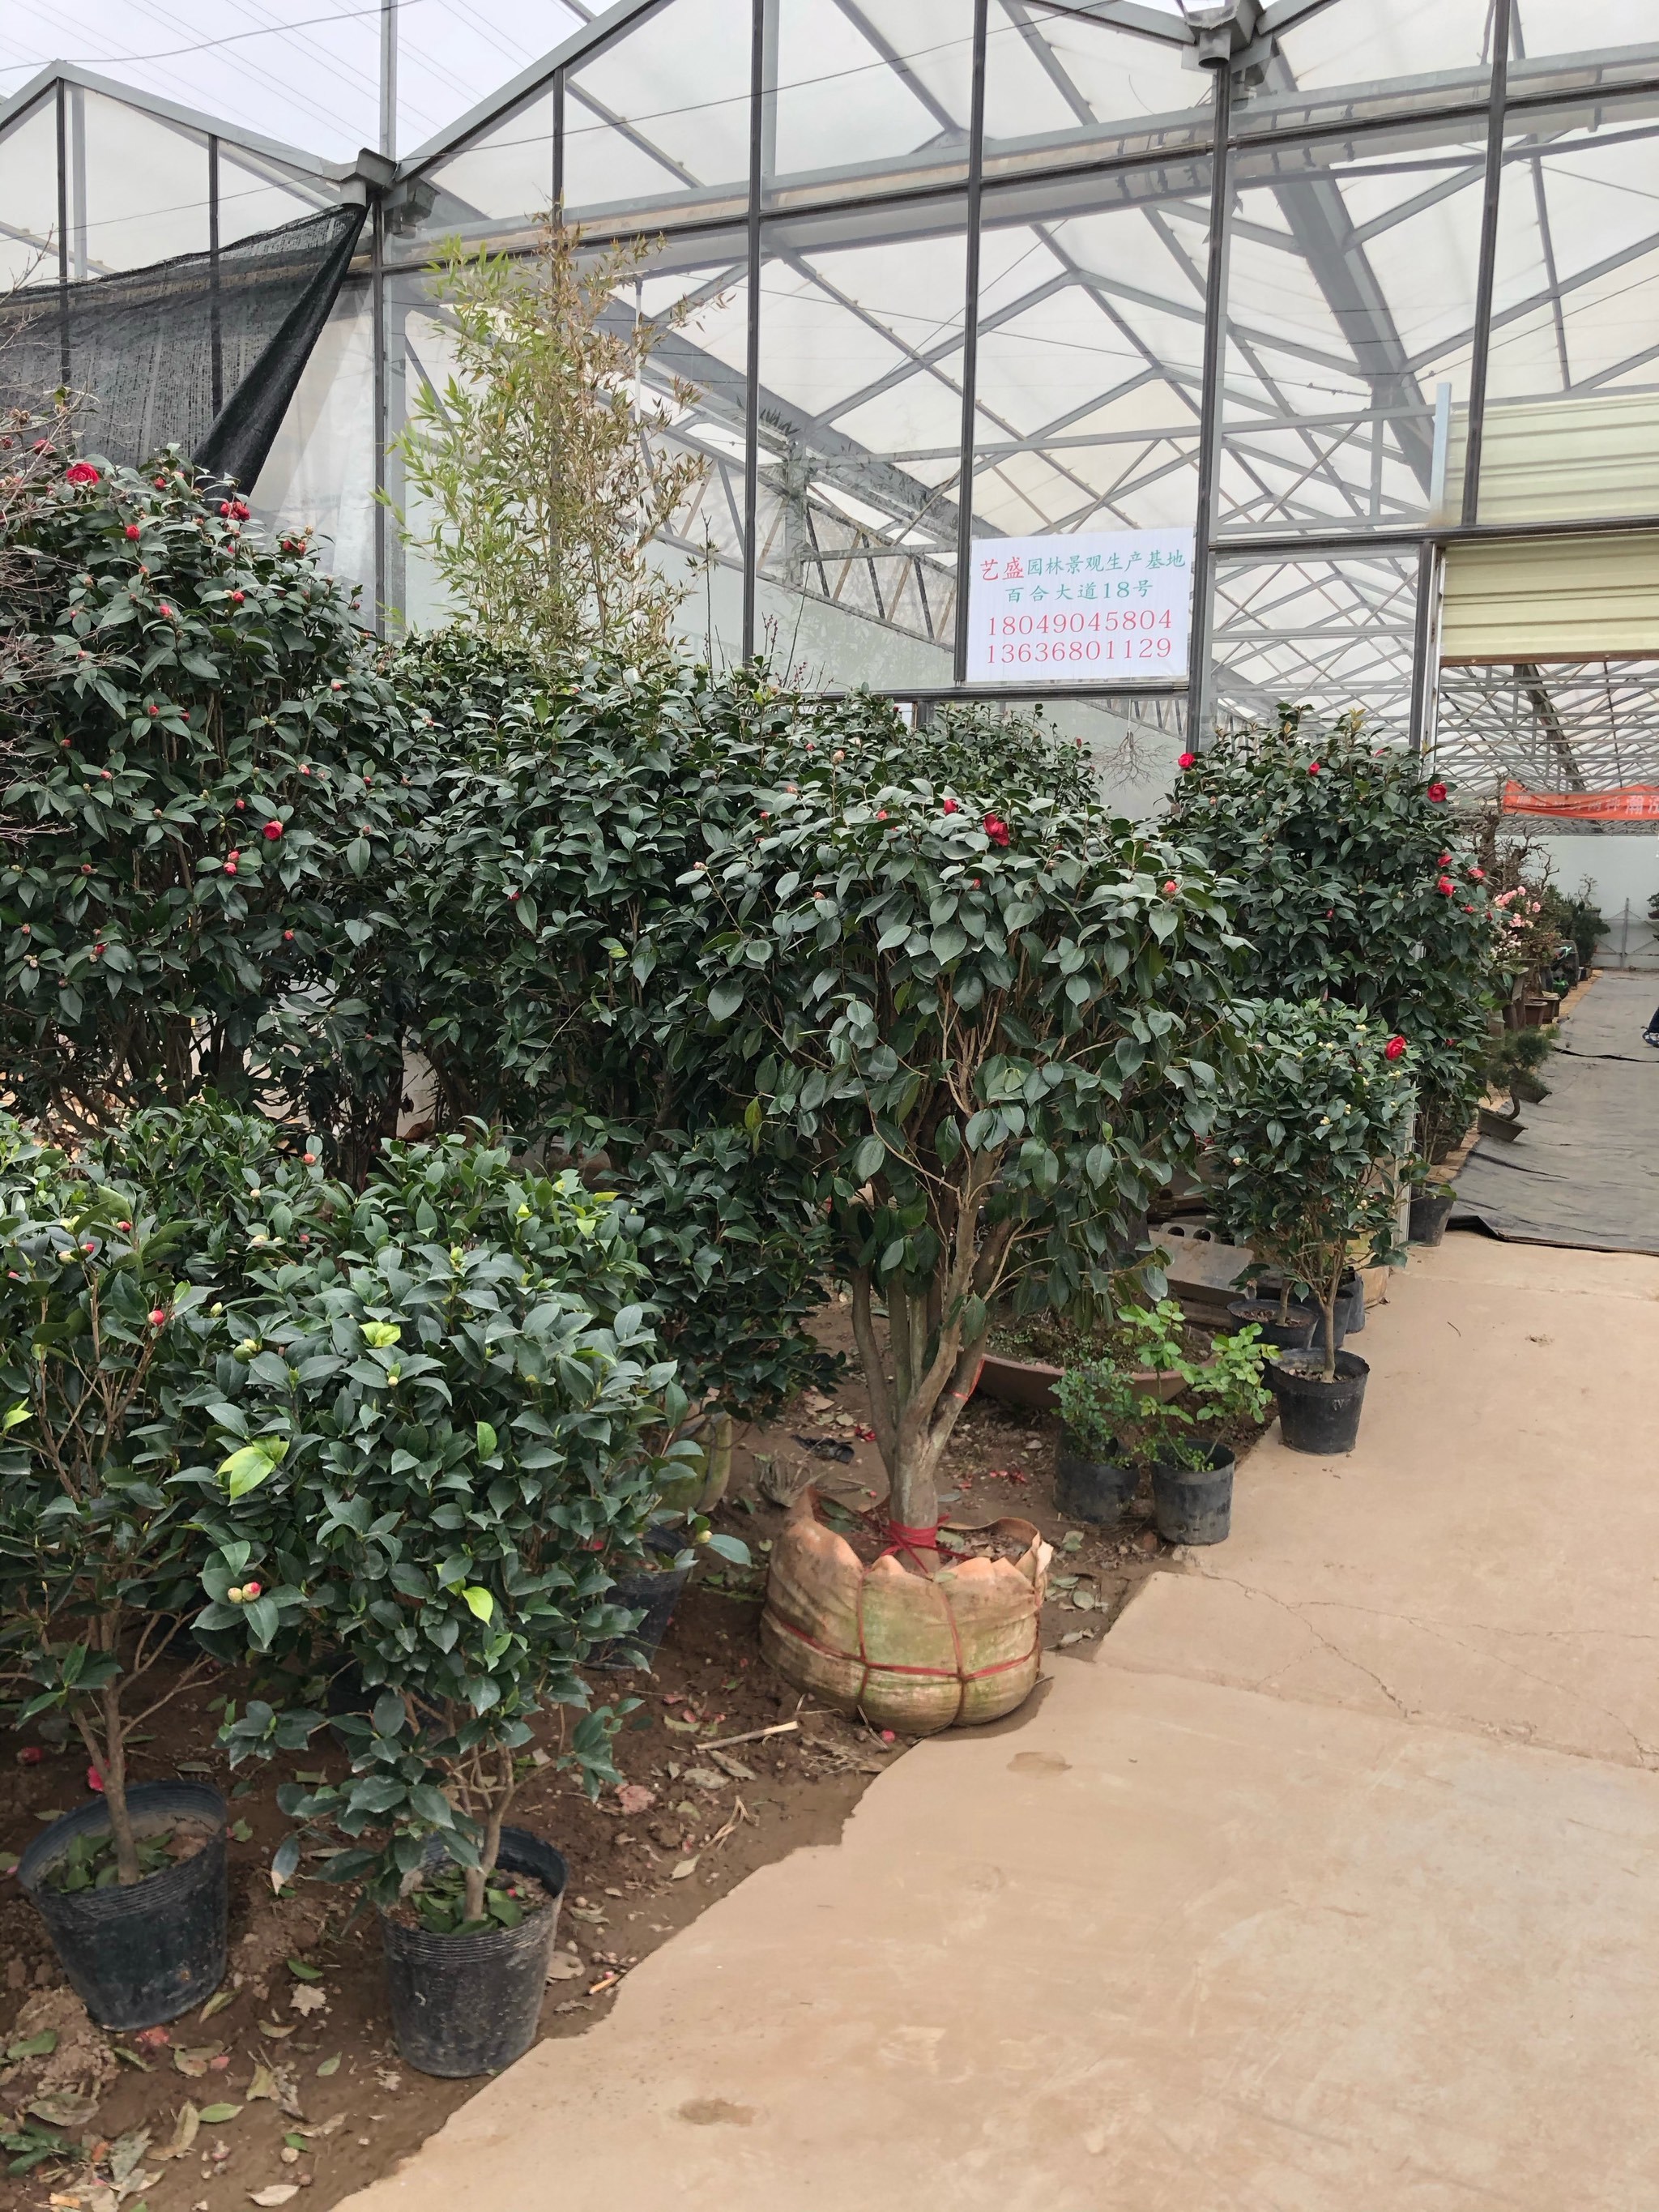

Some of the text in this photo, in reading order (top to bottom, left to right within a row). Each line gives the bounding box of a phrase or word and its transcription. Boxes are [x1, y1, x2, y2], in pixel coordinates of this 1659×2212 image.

[980, 549, 1186, 581] 艺盛园林景观生产基地
[1005, 579, 1154, 603] 百合大道18号
[988, 609, 1172, 636] 18049045804
[987, 638, 1171, 664] 13636801129
